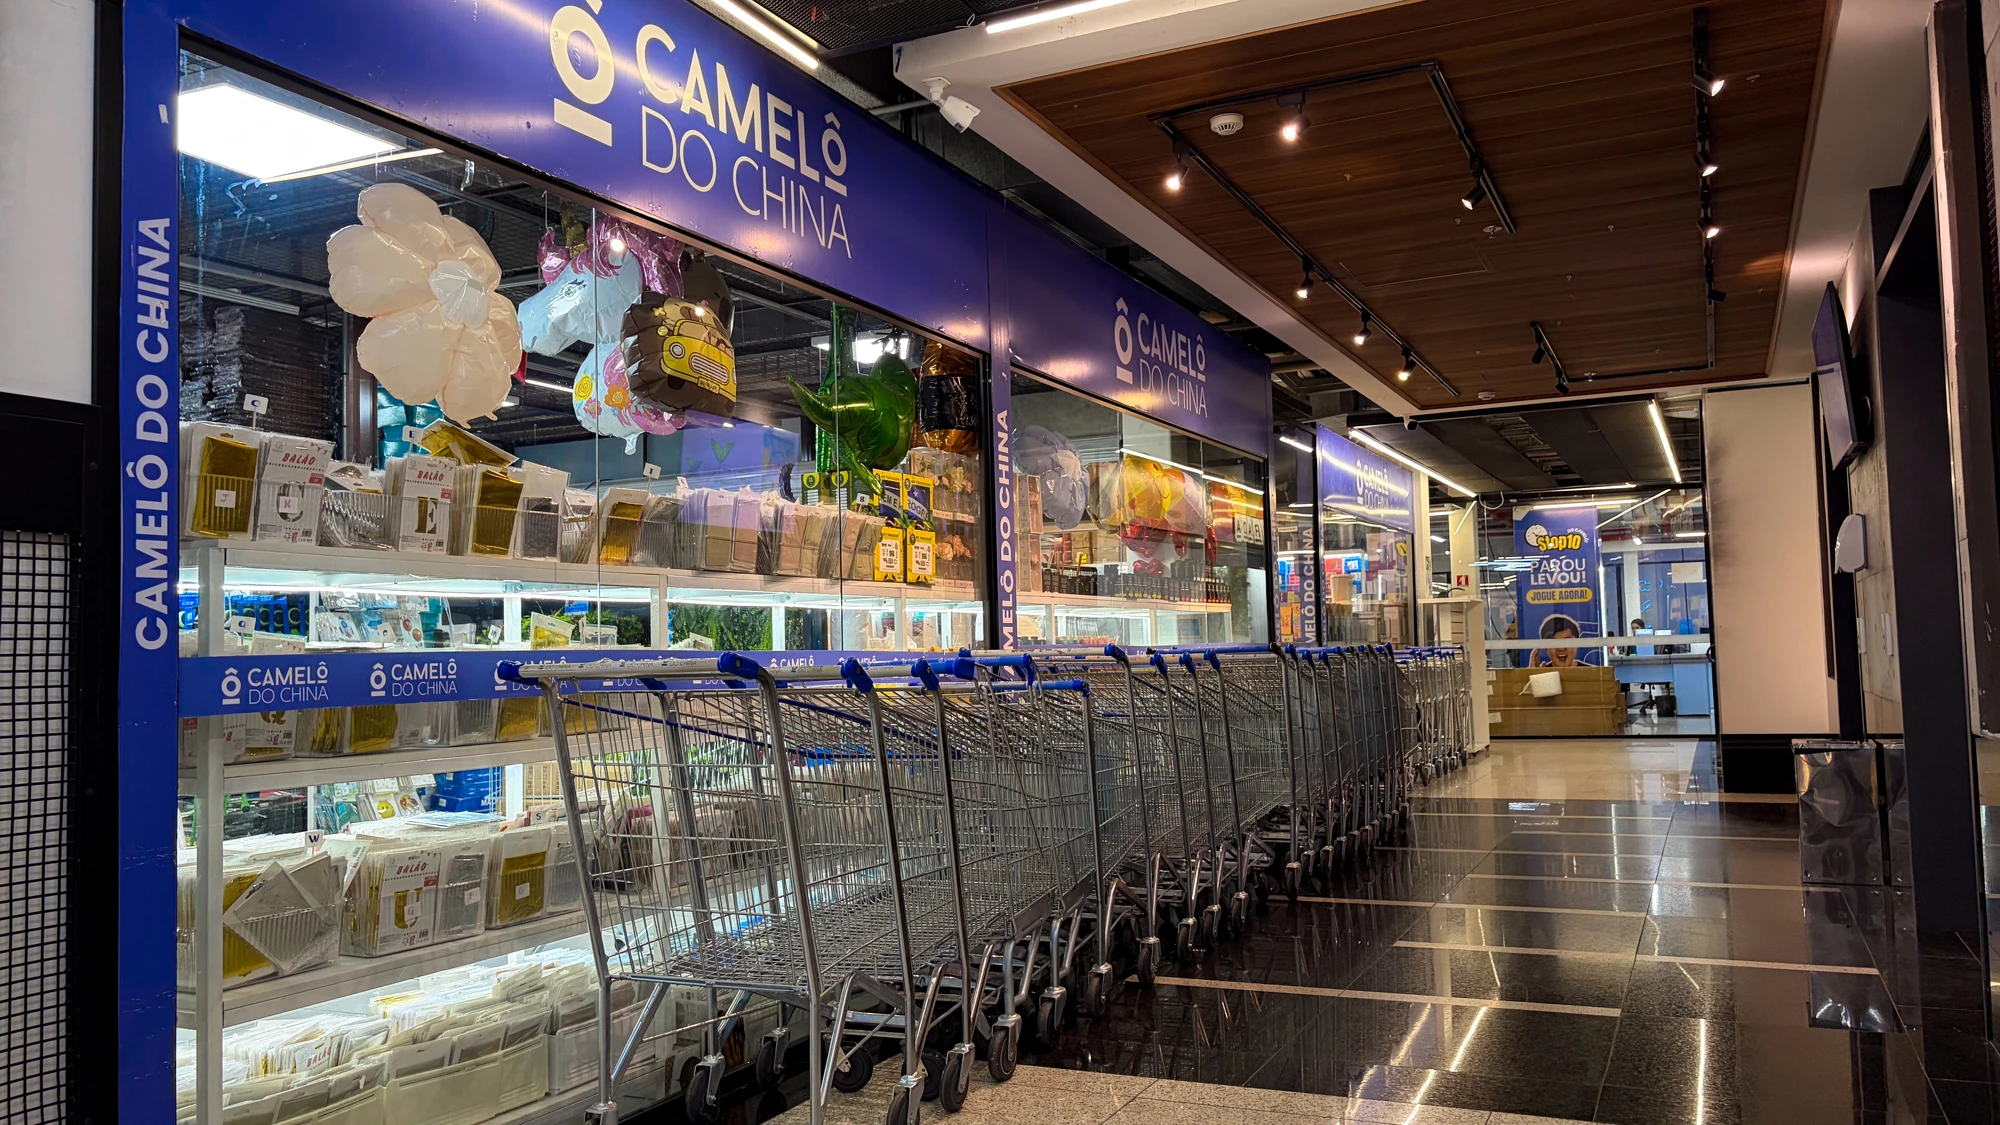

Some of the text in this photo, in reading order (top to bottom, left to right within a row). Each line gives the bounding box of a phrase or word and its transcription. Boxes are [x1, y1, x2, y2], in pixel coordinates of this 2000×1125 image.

[635, 24, 848, 197] CAMELÔ
[641, 105, 852, 259] DO CHINA
[1137, 312, 1206, 382] CAMELÔ
[1140, 358, 1208, 418] DO CHINA
[126, 217, 170, 651] CAMELÔ DO CHINA
[282, 452, 316, 466] BALÃO
[997, 410, 1010, 508] CHINA
[417, 470, 444, 481] BALÃO
[1000, 516, 1011, 555] DO
[1530, 558, 1586, 573] PAROU
[1530, 571, 1587, 586] LEVOU!
[1304, 580, 1315, 602] DO
[1531, 589, 1588, 602] JOGUE AGORA!
[247, 661, 329, 687] CAMELÔ
[391, 658, 457, 681] CAMELÔ
[249, 686, 329, 705] DO CHINA
[392, 680, 458, 697] DO CHINA
[308, 833, 320, 844] W
[396, 860, 428, 875] BALÃO
